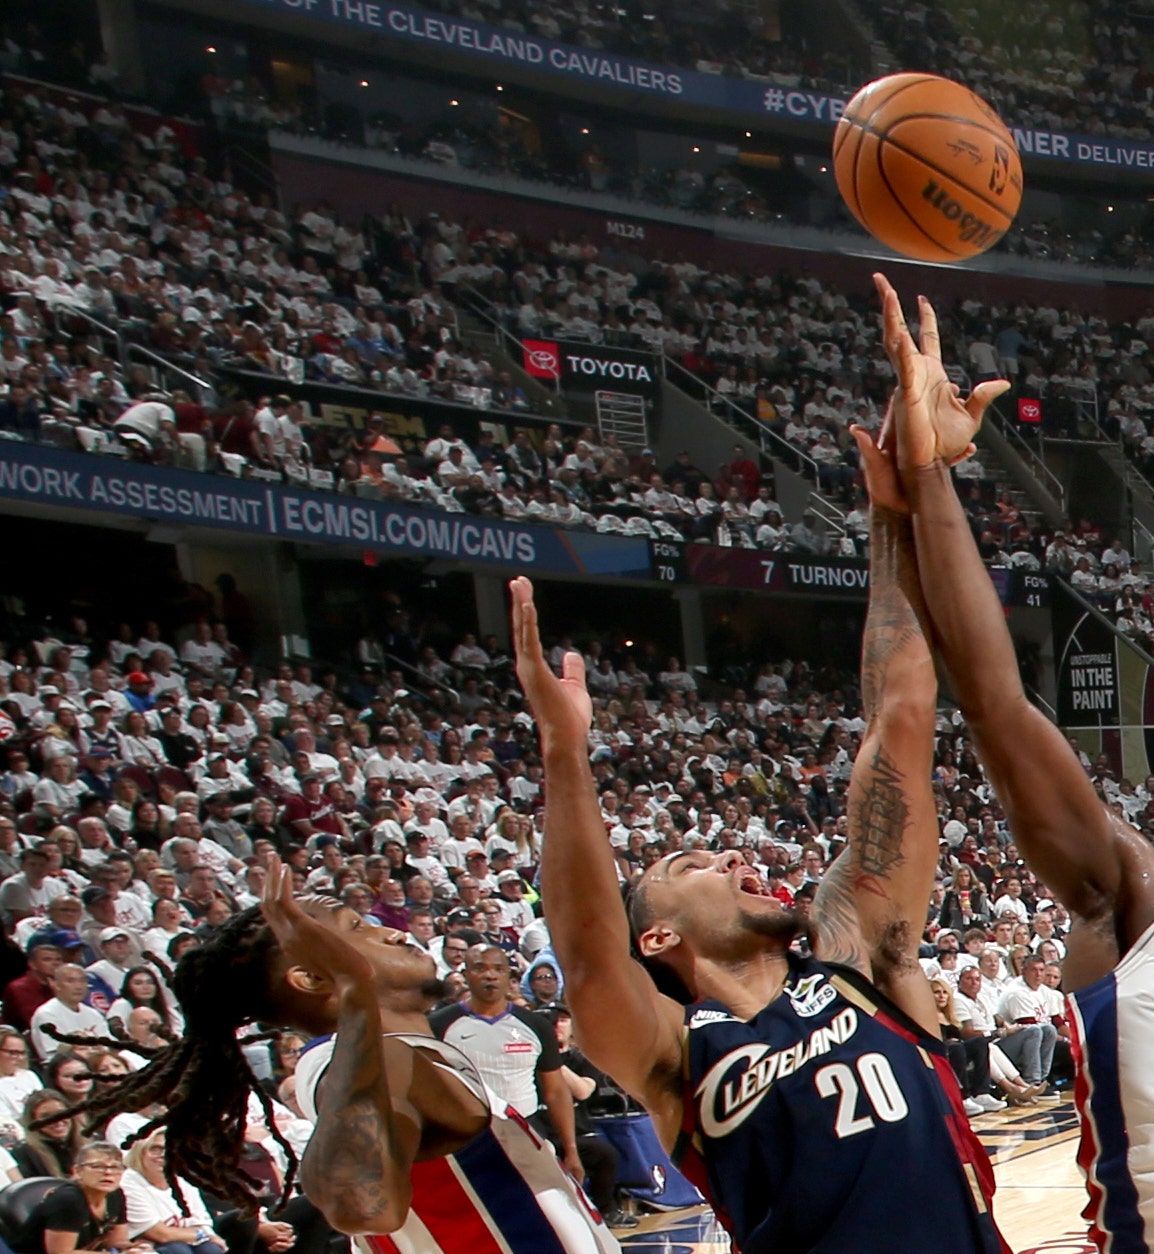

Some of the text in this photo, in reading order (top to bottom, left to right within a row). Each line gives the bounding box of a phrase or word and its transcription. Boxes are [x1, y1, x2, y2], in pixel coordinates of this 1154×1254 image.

[329, 0, 684, 95] THE CLEVELAND CAVALIERS
[1009, 127, 1070, 158] NER
[606, 221, 646, 240] M124
[566, 355, 652, 383] TOYOTA
[90, 475, 263, 526] ASSESSMENT
[283, 496, 536, 563] ECMSI.COM/CAVS
[653, 542, 680, 558] FG%
[659, 567, 676, 582] 70
[760, 560, 776, 584] 7
[1024, 575, 1049, 590] FG%
[1026, 593, 1042, 608] 41
[1071, 667, 1114, 688] IN THE
[1072, 690, 1115, 710] PAINT
[695, 1009, 728, 1021] NIKE
[694, 1007, 859, 1139] CLEVELAND
[813, 1051, 910, 1140] 20
